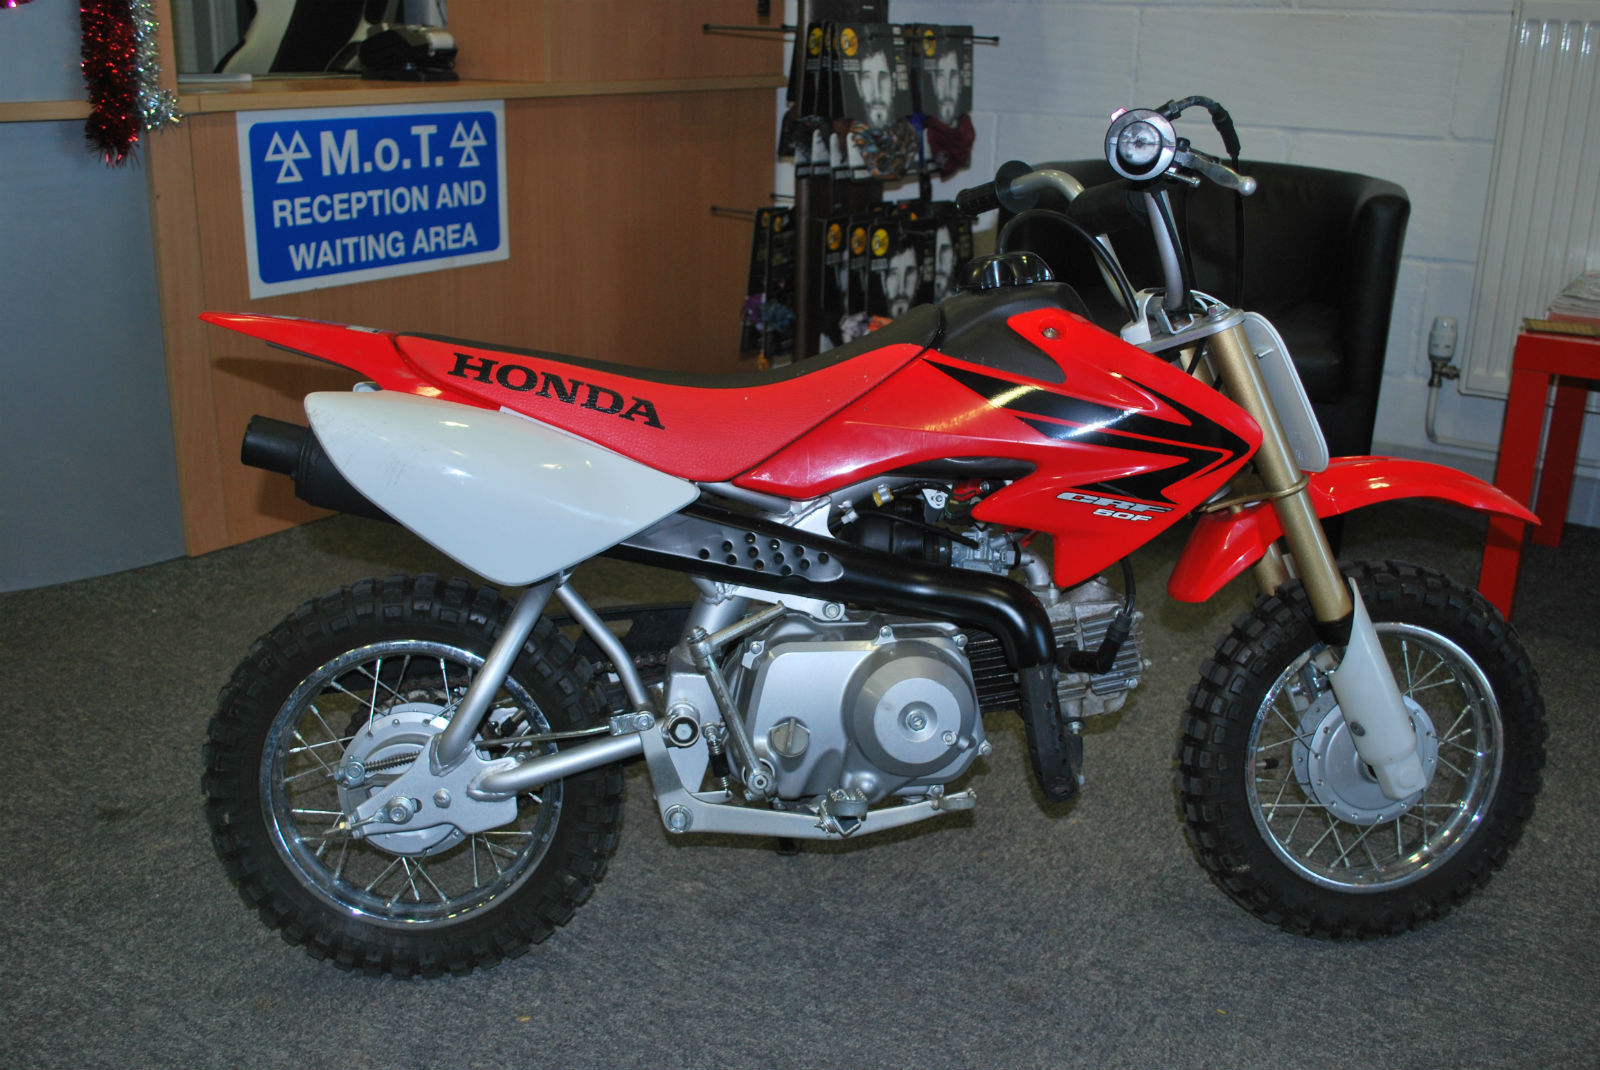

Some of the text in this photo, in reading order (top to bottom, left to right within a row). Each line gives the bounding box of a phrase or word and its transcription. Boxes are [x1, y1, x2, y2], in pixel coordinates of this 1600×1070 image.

[319, 124, 445, 177] M.o.T.
[272, 179, 487, 229] RECEPTION AND
[288, 221, 479, 272] WAITING AREA
[447, 352, 666, 430] HONDA
[1056, 491, 1175, 513] CRF
[1092, 507, 1154, 522] 50F
